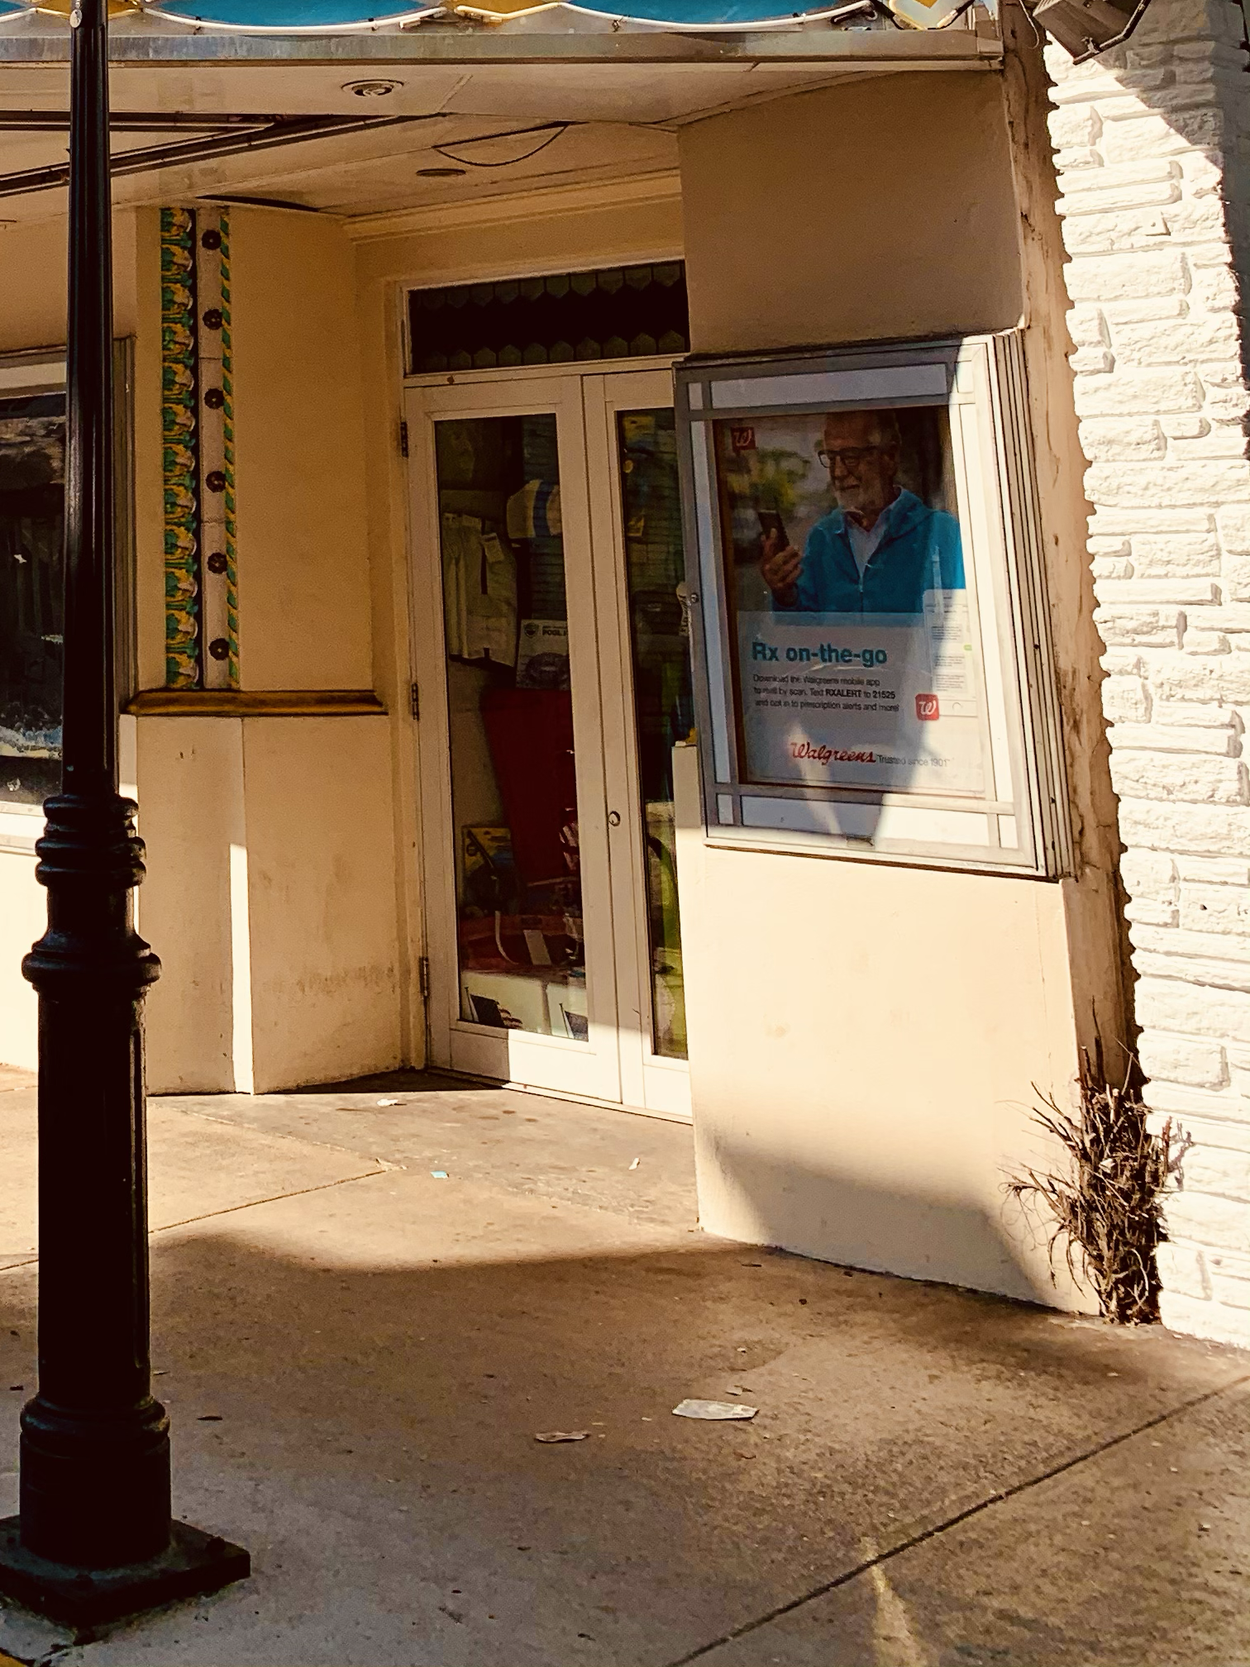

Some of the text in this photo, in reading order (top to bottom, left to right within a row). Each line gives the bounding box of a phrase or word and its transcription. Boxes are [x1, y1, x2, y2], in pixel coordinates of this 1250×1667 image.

[752, 642, 888, 668] Rx on-the-go
[825, 689, 862, 698] RXALERT
[872, 691, 896, 700] 21525
[790, 741, 877, 766] Walgreens
